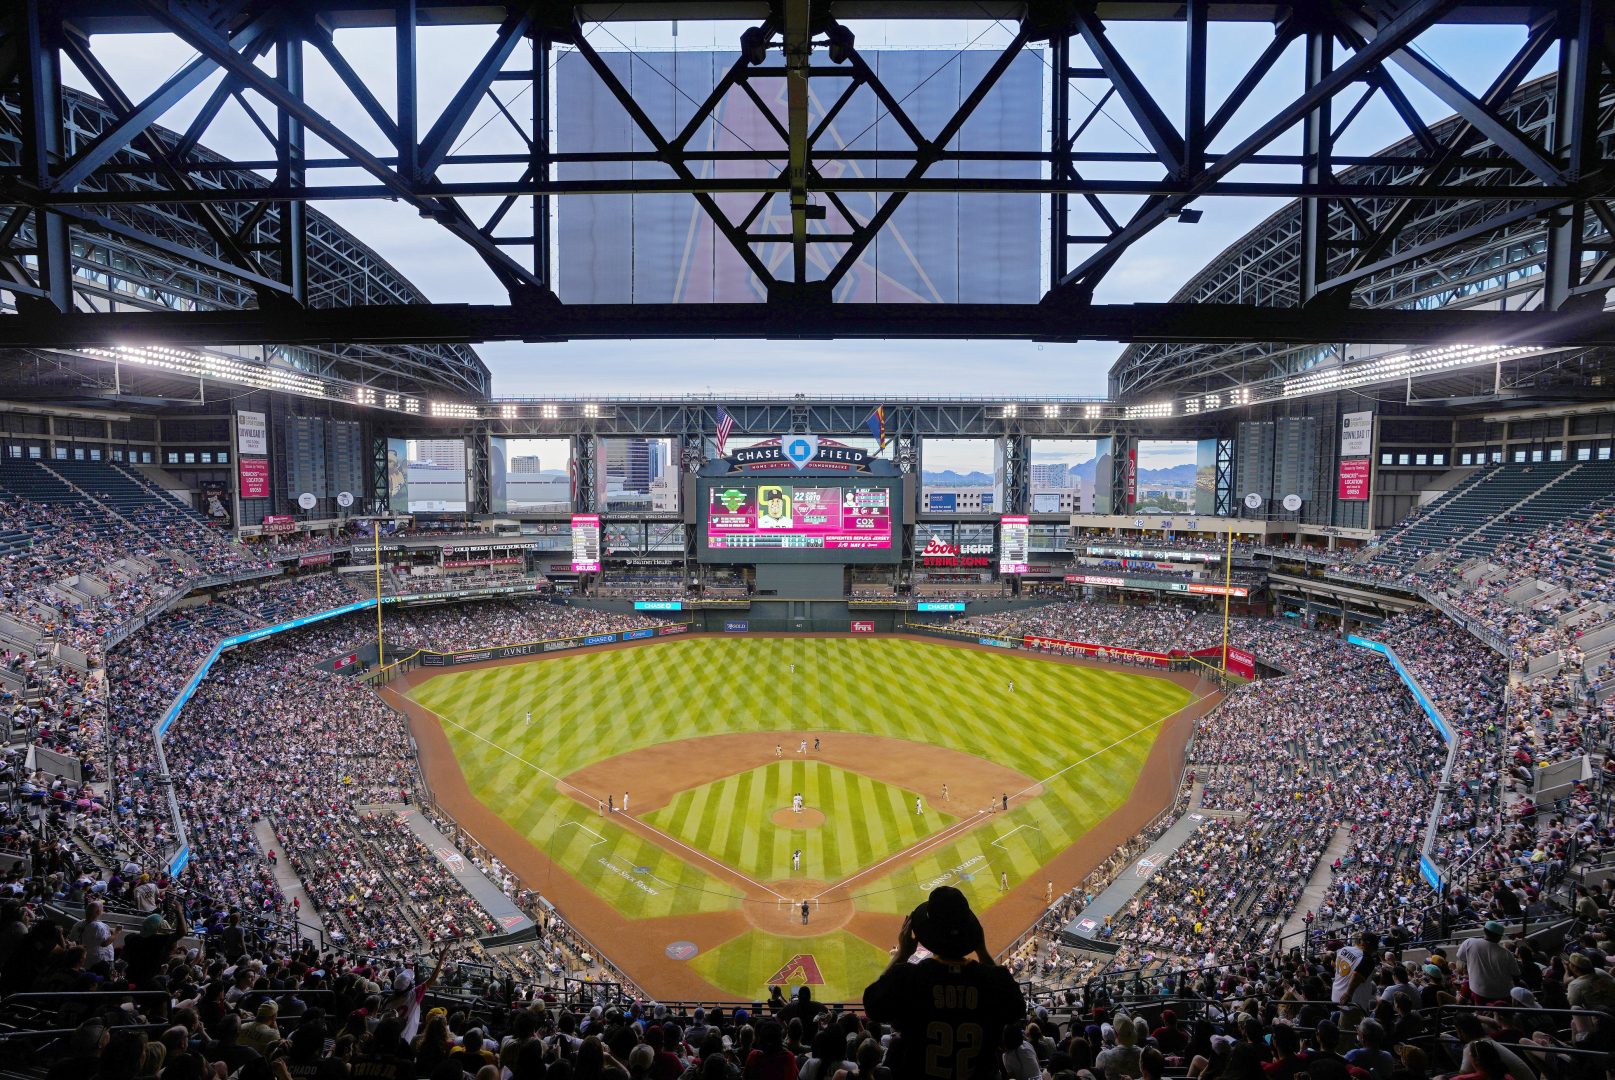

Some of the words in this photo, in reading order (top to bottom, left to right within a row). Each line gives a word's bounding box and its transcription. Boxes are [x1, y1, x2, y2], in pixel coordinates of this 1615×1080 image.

[1343, 429, 1364, 440] DOWNLOAD
[737, 449, 779, 461] CHASE
[821, 449, 862, 461] FIELD
[795, 492, 804, 500] 22
[924, 540, 960, 554] Coors
[960, 544, 994, 554] LIGHT
[924, 557, 958, 566] STRIKE
[960, 557, 989, 566] ZONE
[1127, 561, 1156, 570] ULTRA
[504, 645, 532, 656] AVNET
[932, 984, 978, 1010] SOTO
[926, 1020, 983, 1080] 22
